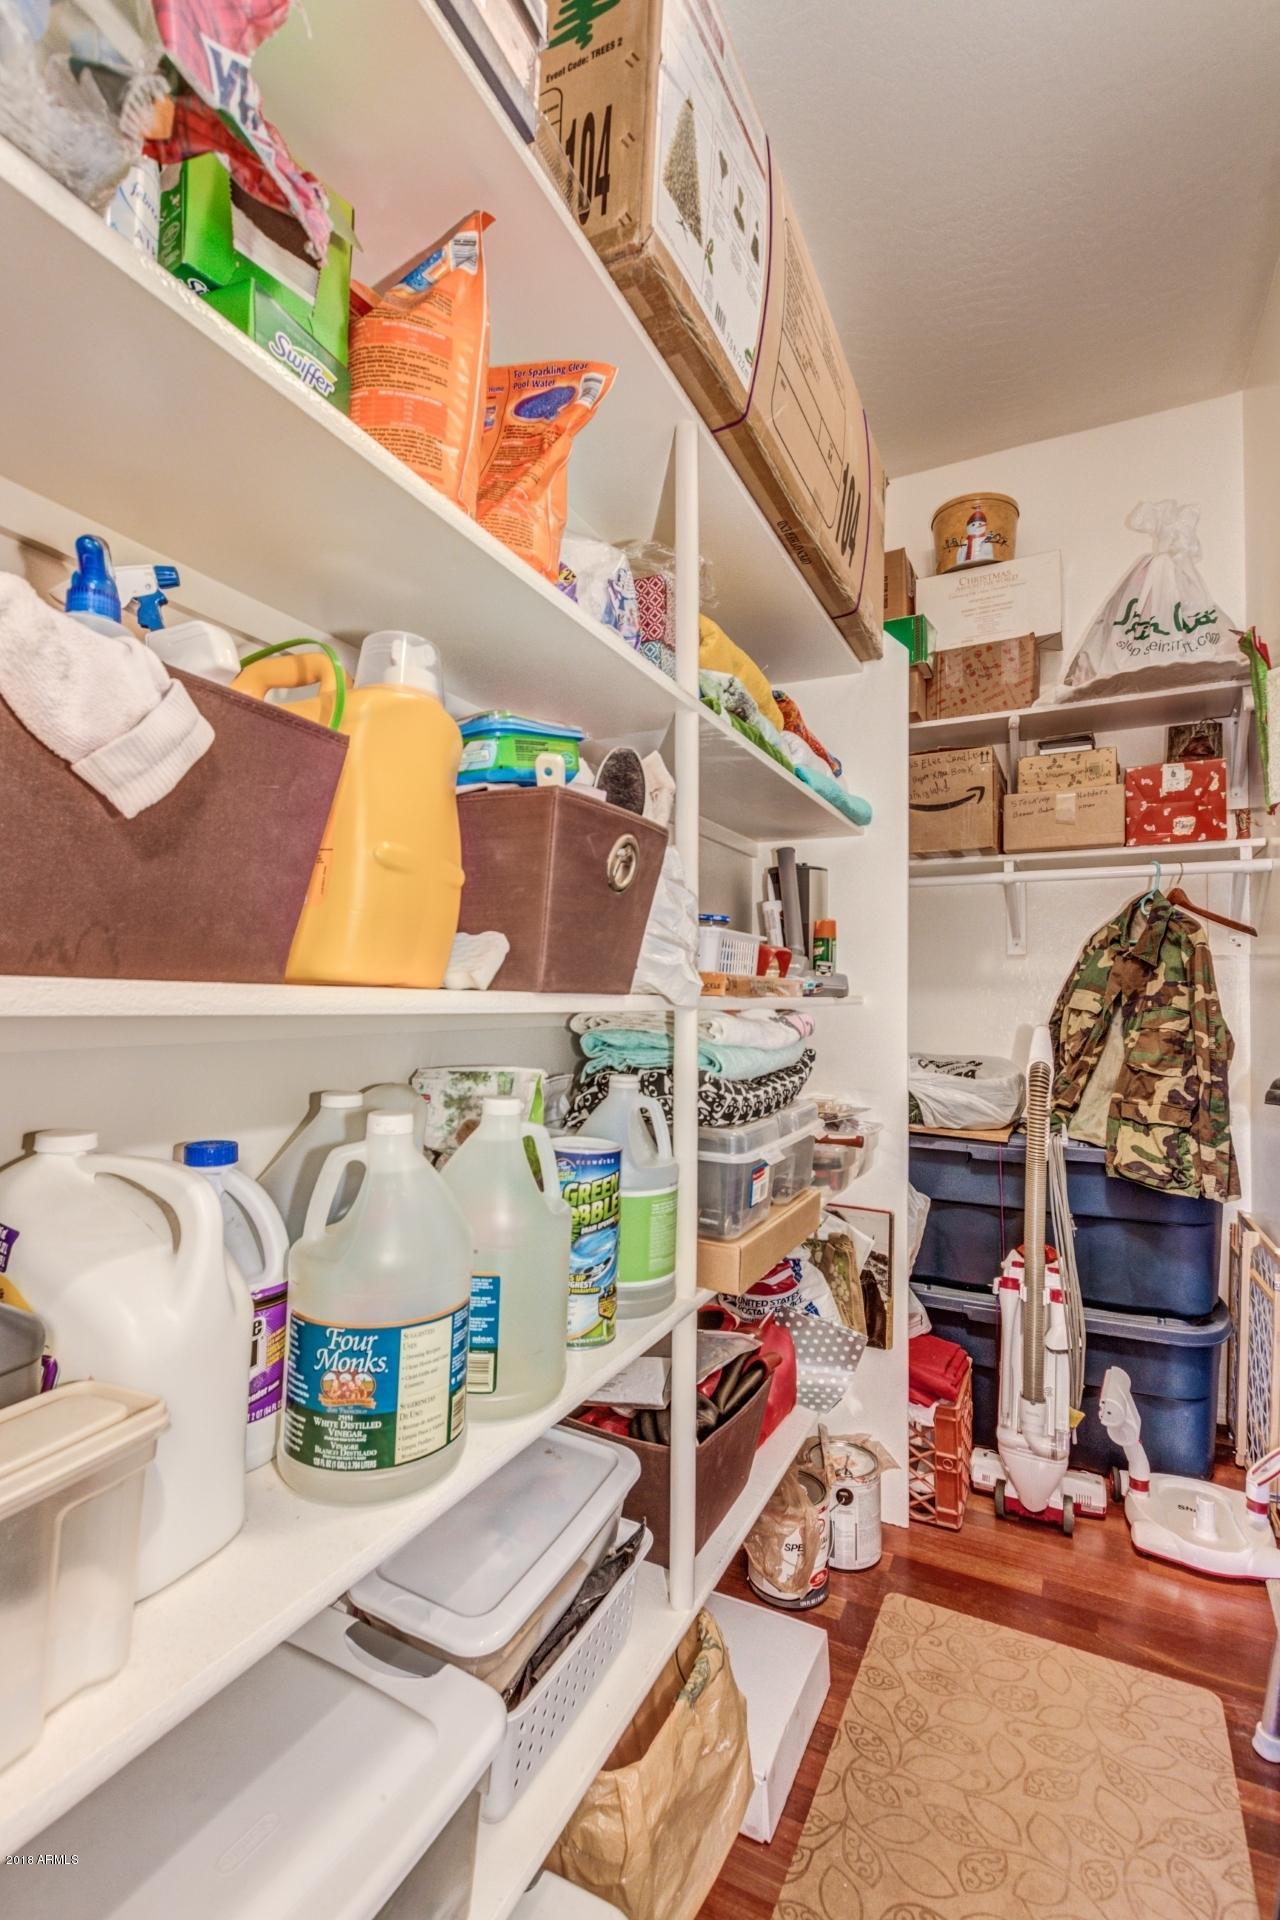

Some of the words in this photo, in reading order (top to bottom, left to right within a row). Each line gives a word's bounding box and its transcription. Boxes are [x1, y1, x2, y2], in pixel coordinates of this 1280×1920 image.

[546, 66, 566, 83] Event
[567, 56, 589, 72] Code:
[591, 40, 615, 59] TREES
[617, 36, 623, 47] 2
[565, 104, 612, 226] 104
[268, 331, 336, 398] Swiffer
[513, 369, 526, 379] For
[529, 365, 566, 378] Sparkling
[568, 362, 589, 373] Clear
[513, 380, 529, 390] Pool
[532, 378, 556, 388] Water
[835, 462, 861, 568] 104
[958, 569, 1013, 587] CHRISTMAS
[562, 1171, 620, 1207] GREEN
[737, 1296, 769, 1308] UNITED
[326, 1327, 379, 1353] Four
[313, 1416, 339, 1429] WHITE
[340, 1420, 382, 1430] DISTILLED
[784, 1543, 806, 1552] SPE
